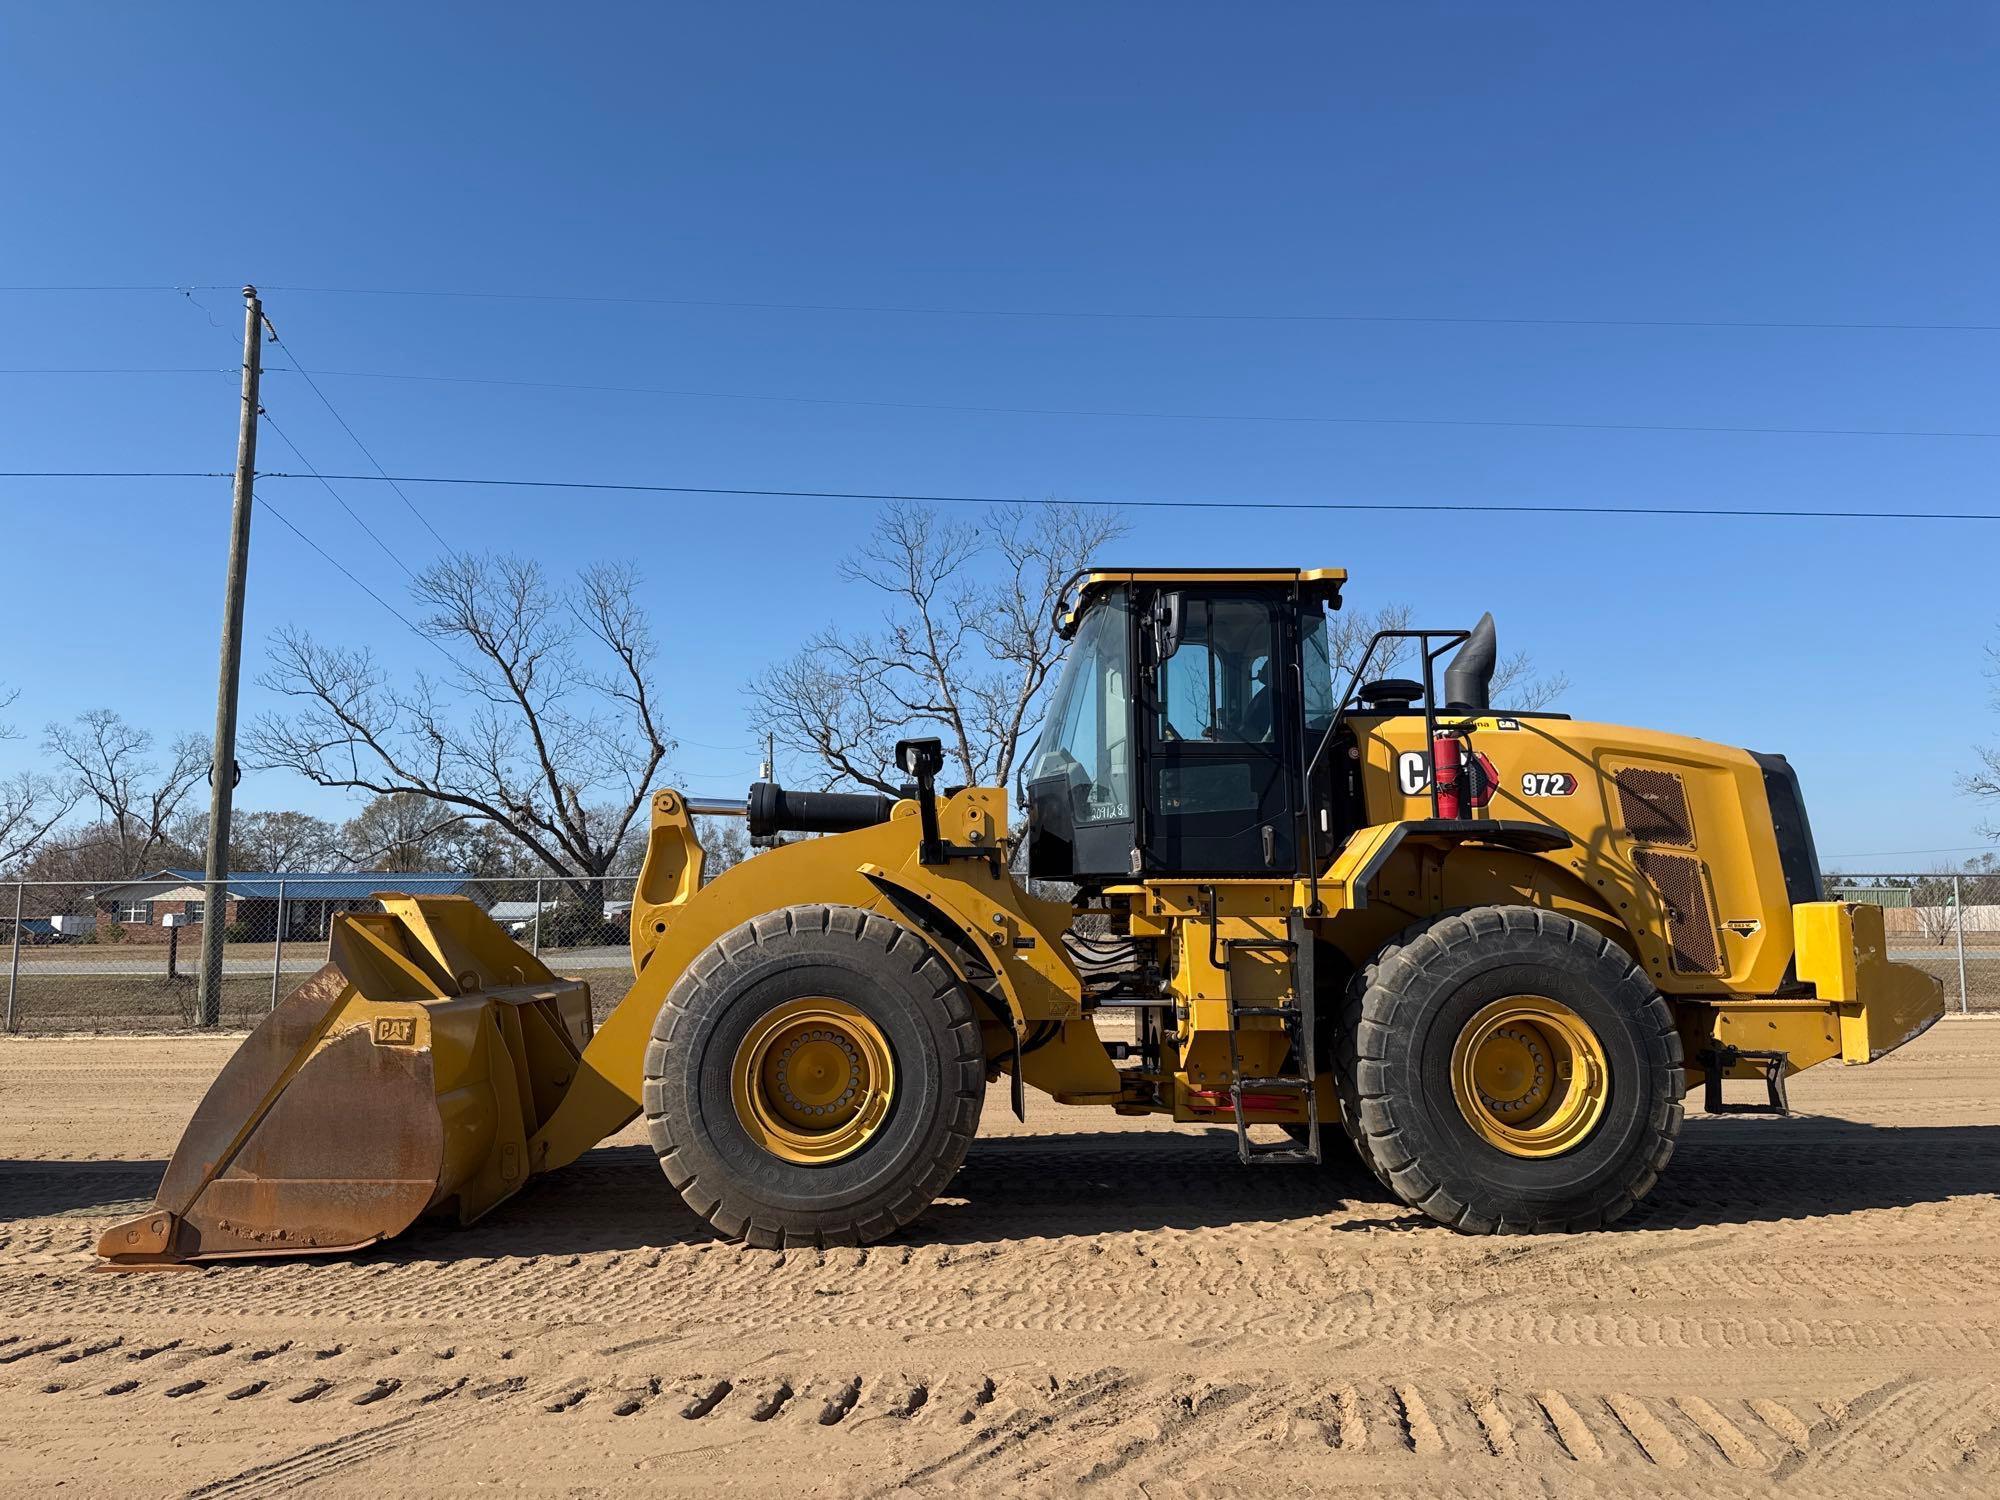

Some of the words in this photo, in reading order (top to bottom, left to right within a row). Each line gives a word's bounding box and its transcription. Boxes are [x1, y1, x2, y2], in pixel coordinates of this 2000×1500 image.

[1522, 774, 1565, 795] 972
[1091, 803, 1124, 821] 209128
[378, 1021, 412, 1041] CAT
